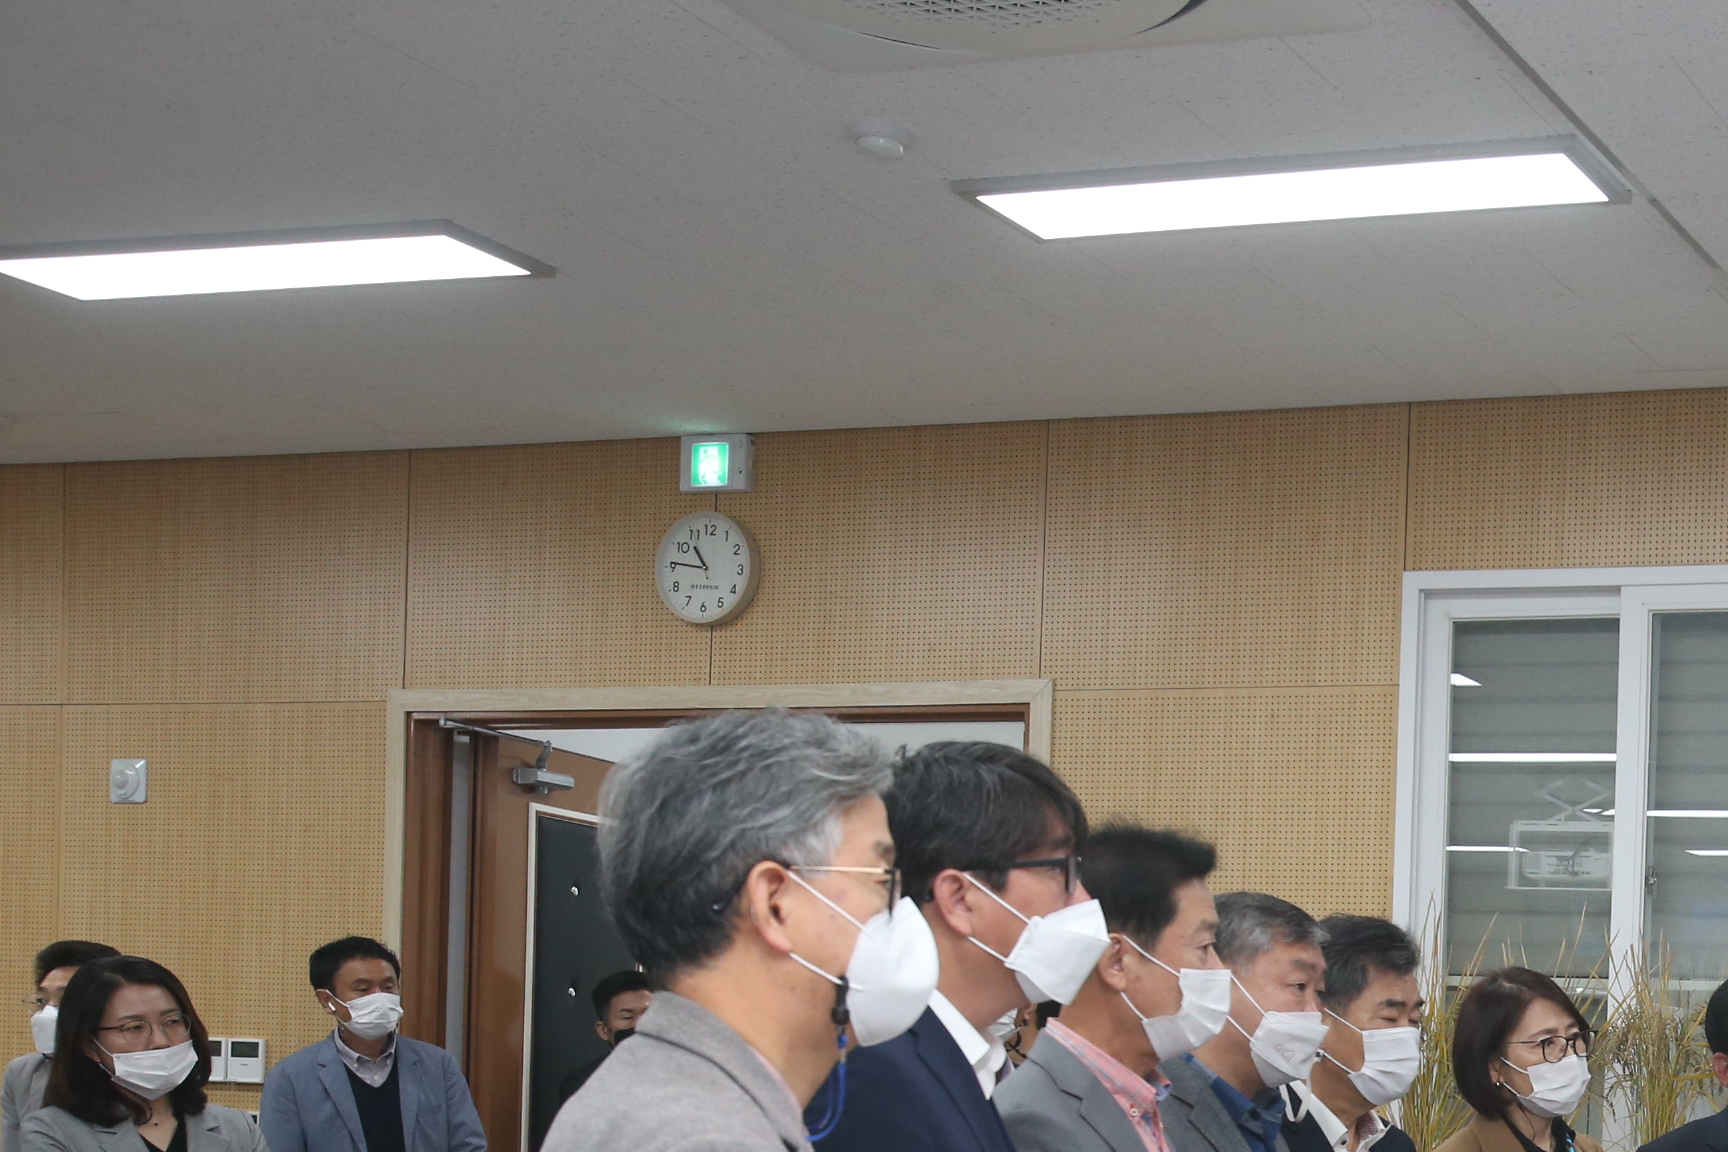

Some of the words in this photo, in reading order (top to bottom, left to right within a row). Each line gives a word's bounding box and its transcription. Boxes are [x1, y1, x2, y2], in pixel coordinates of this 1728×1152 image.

[689, 529, 701, 541] 11
[704, 524, 717, 536] 12
[724, 530, 730, 542] 1
[676, 541, 690, 554] 10
[733, 543, 741, 556] 2
[669, 561, 677, 573] 9
[736, 564, 744, 576] 3
[672, 581, 680, 593] 8
[730, 583, 737, 595] 4
[684, 595, 692, 607] 7
[699, 601, 707, 613] 6
[717, 597, 725, 609] 5
